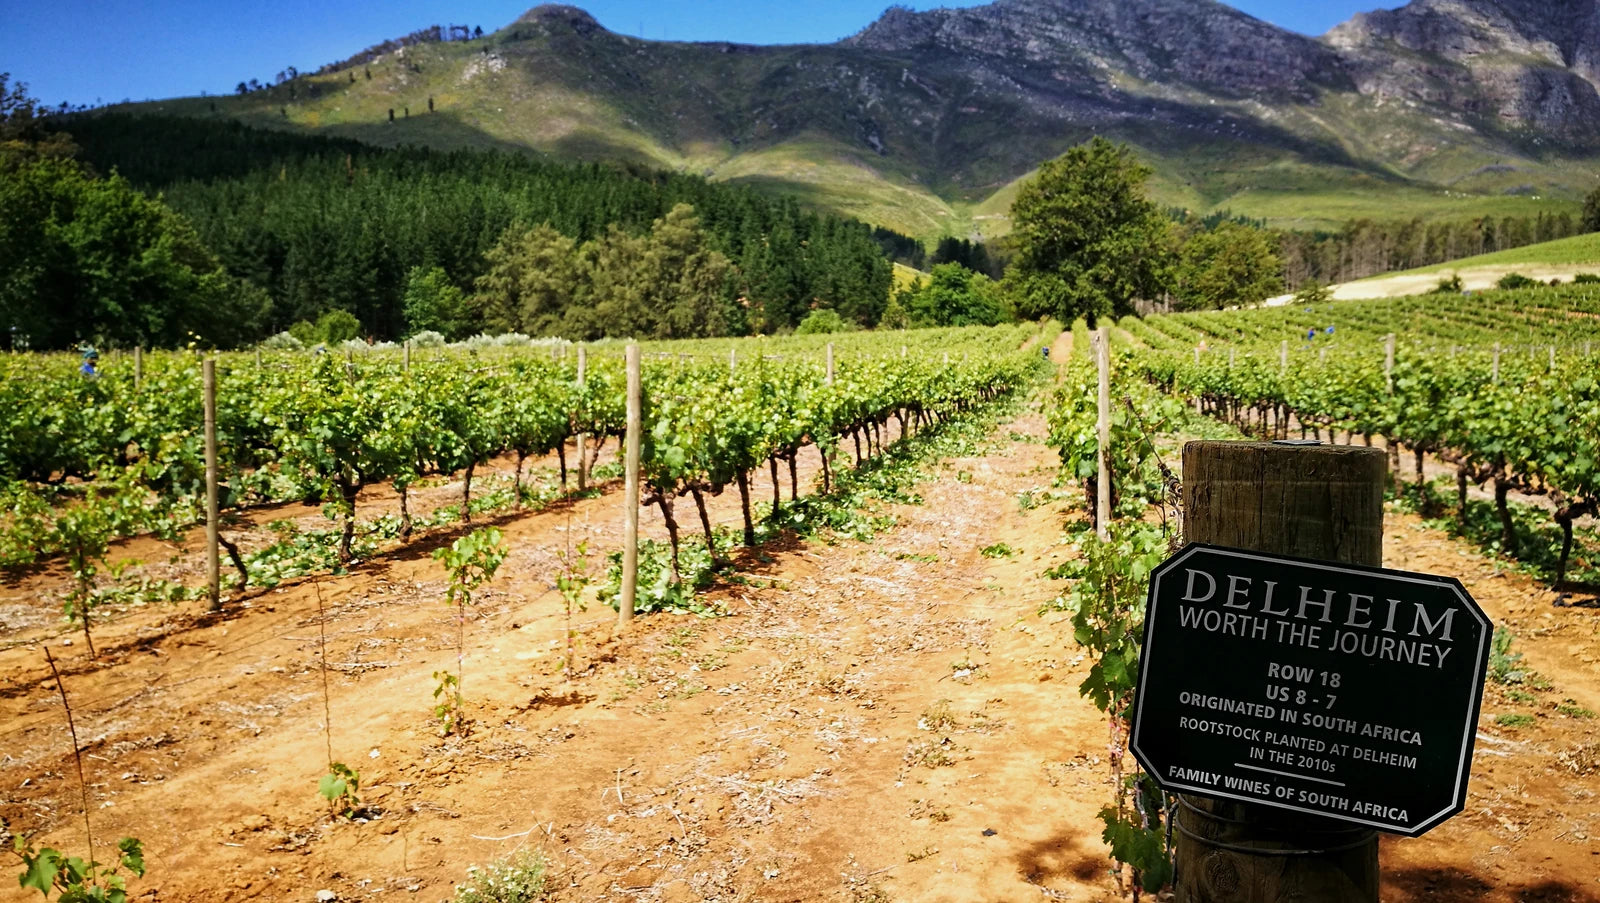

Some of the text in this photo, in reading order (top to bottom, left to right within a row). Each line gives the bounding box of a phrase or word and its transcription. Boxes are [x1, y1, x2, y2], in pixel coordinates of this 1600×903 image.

[1180, 568, 1459, 642] DELHEIM
[1179, 605, 1452, 669] WORTH THE JOURNEY
[1265, 684, 1290, 702] US
[1295, 689, 1307, 705] 8
[1325, 694, 1337, 709] 7
[1268, 662, 1342, 688] ROW 18
[1179, 691, 1423, 746] ORIGINATED IN SOUTH AFRICA
[1179, 716, 1417, 769] ROOTSTOCK PLANTED AT DELHEIM
[1249, 746, 1336, 773] IN THE 2010s
[1168, 765, 1409, 823] FAMILY WINES OF SOUTH AFRICA
